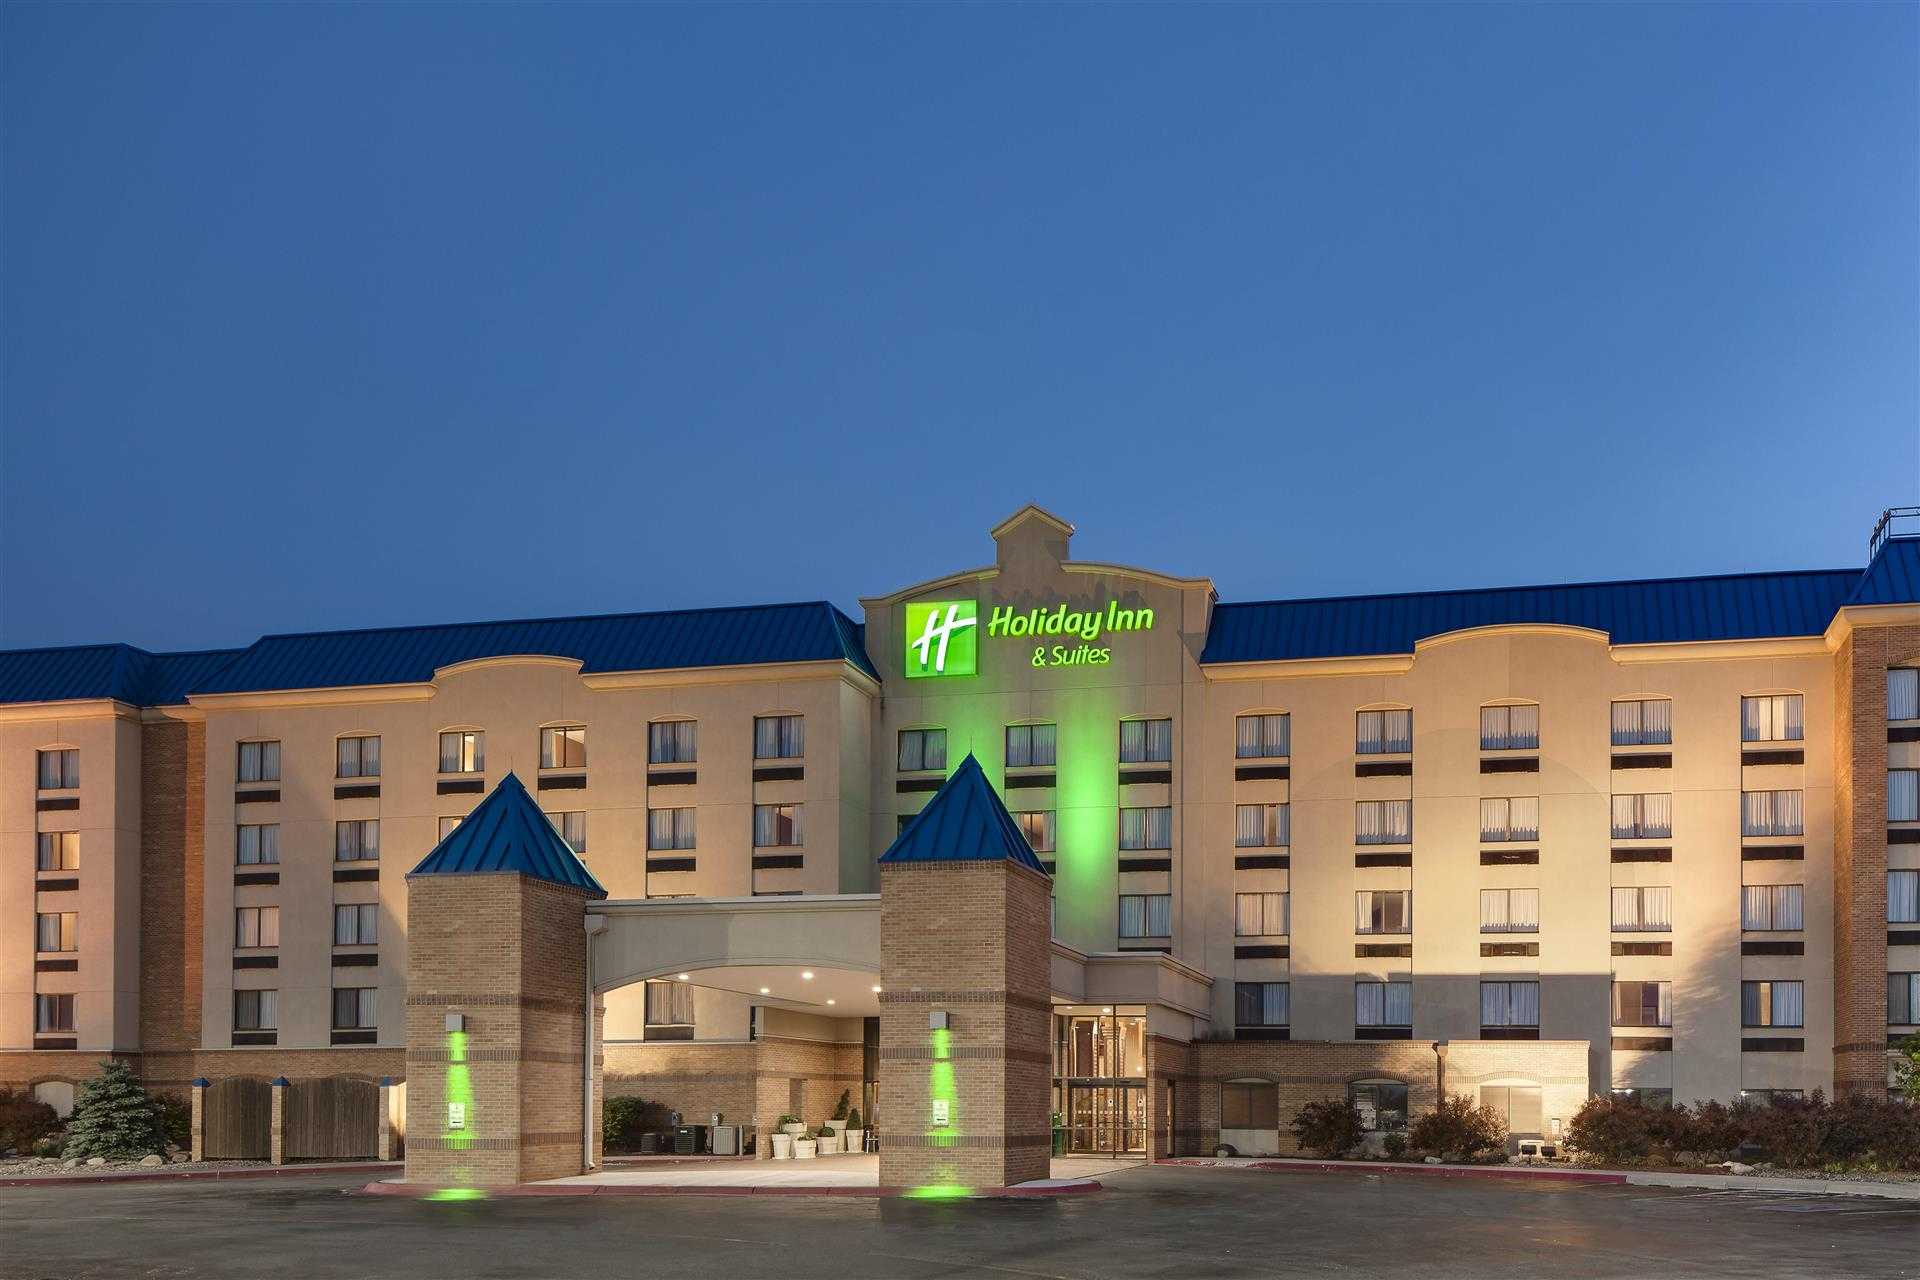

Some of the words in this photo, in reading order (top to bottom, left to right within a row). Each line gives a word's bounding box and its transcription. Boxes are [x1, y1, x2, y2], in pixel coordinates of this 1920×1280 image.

[988, 603, 1102, 641] Holiday
[1107, 600, 1154, 631] Inn
[1031, 646, 1046, 667] &
[1050, 645, 1111, 665] Suites
